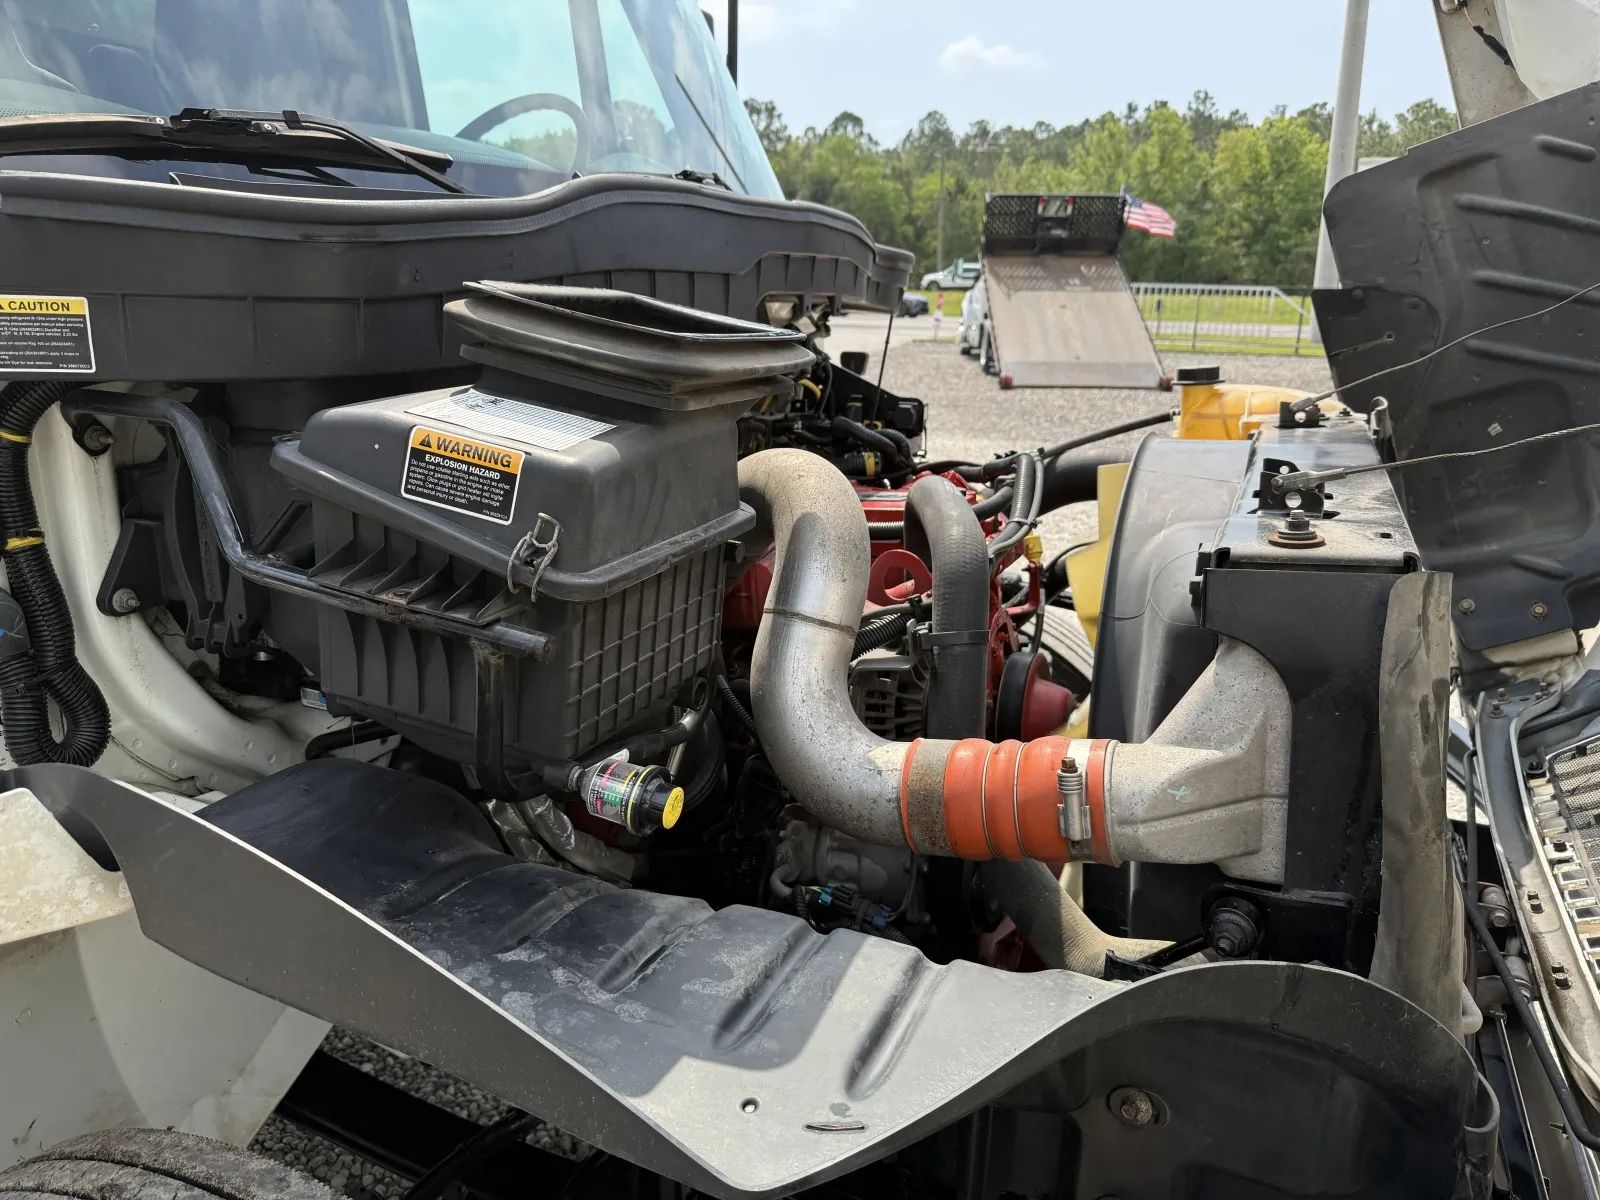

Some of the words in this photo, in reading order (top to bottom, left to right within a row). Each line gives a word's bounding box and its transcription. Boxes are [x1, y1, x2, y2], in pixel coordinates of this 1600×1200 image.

[8, 300, 70, 312] CAUTION
[437, 436, 512, 468] WARNING
[411, 458, 418, 466] Do
[436, 466, 451, 475] volatile
[452, 471, 469, 480] starting
[425, 454, 468, 472] EXPLOSION
[469, 465, 500, 480] HAZARD
[409, 465, 428, 475] propane
[435, 472, 453, 481] gasoline
[467, 481, 483, 489] engine
[490, 487, 504, 495] intake
[467, 487, 482, 495] heater
[416, 486, 436, 496] personal
[436, 492, 449, 500] injury
[424, 481, 435, 489] Can
[435, 485, 449, 493] cause
[449, 489, 465, 497] severe
[465, 493, 481, 501] engine
[481, 497, 500, 507] damage
